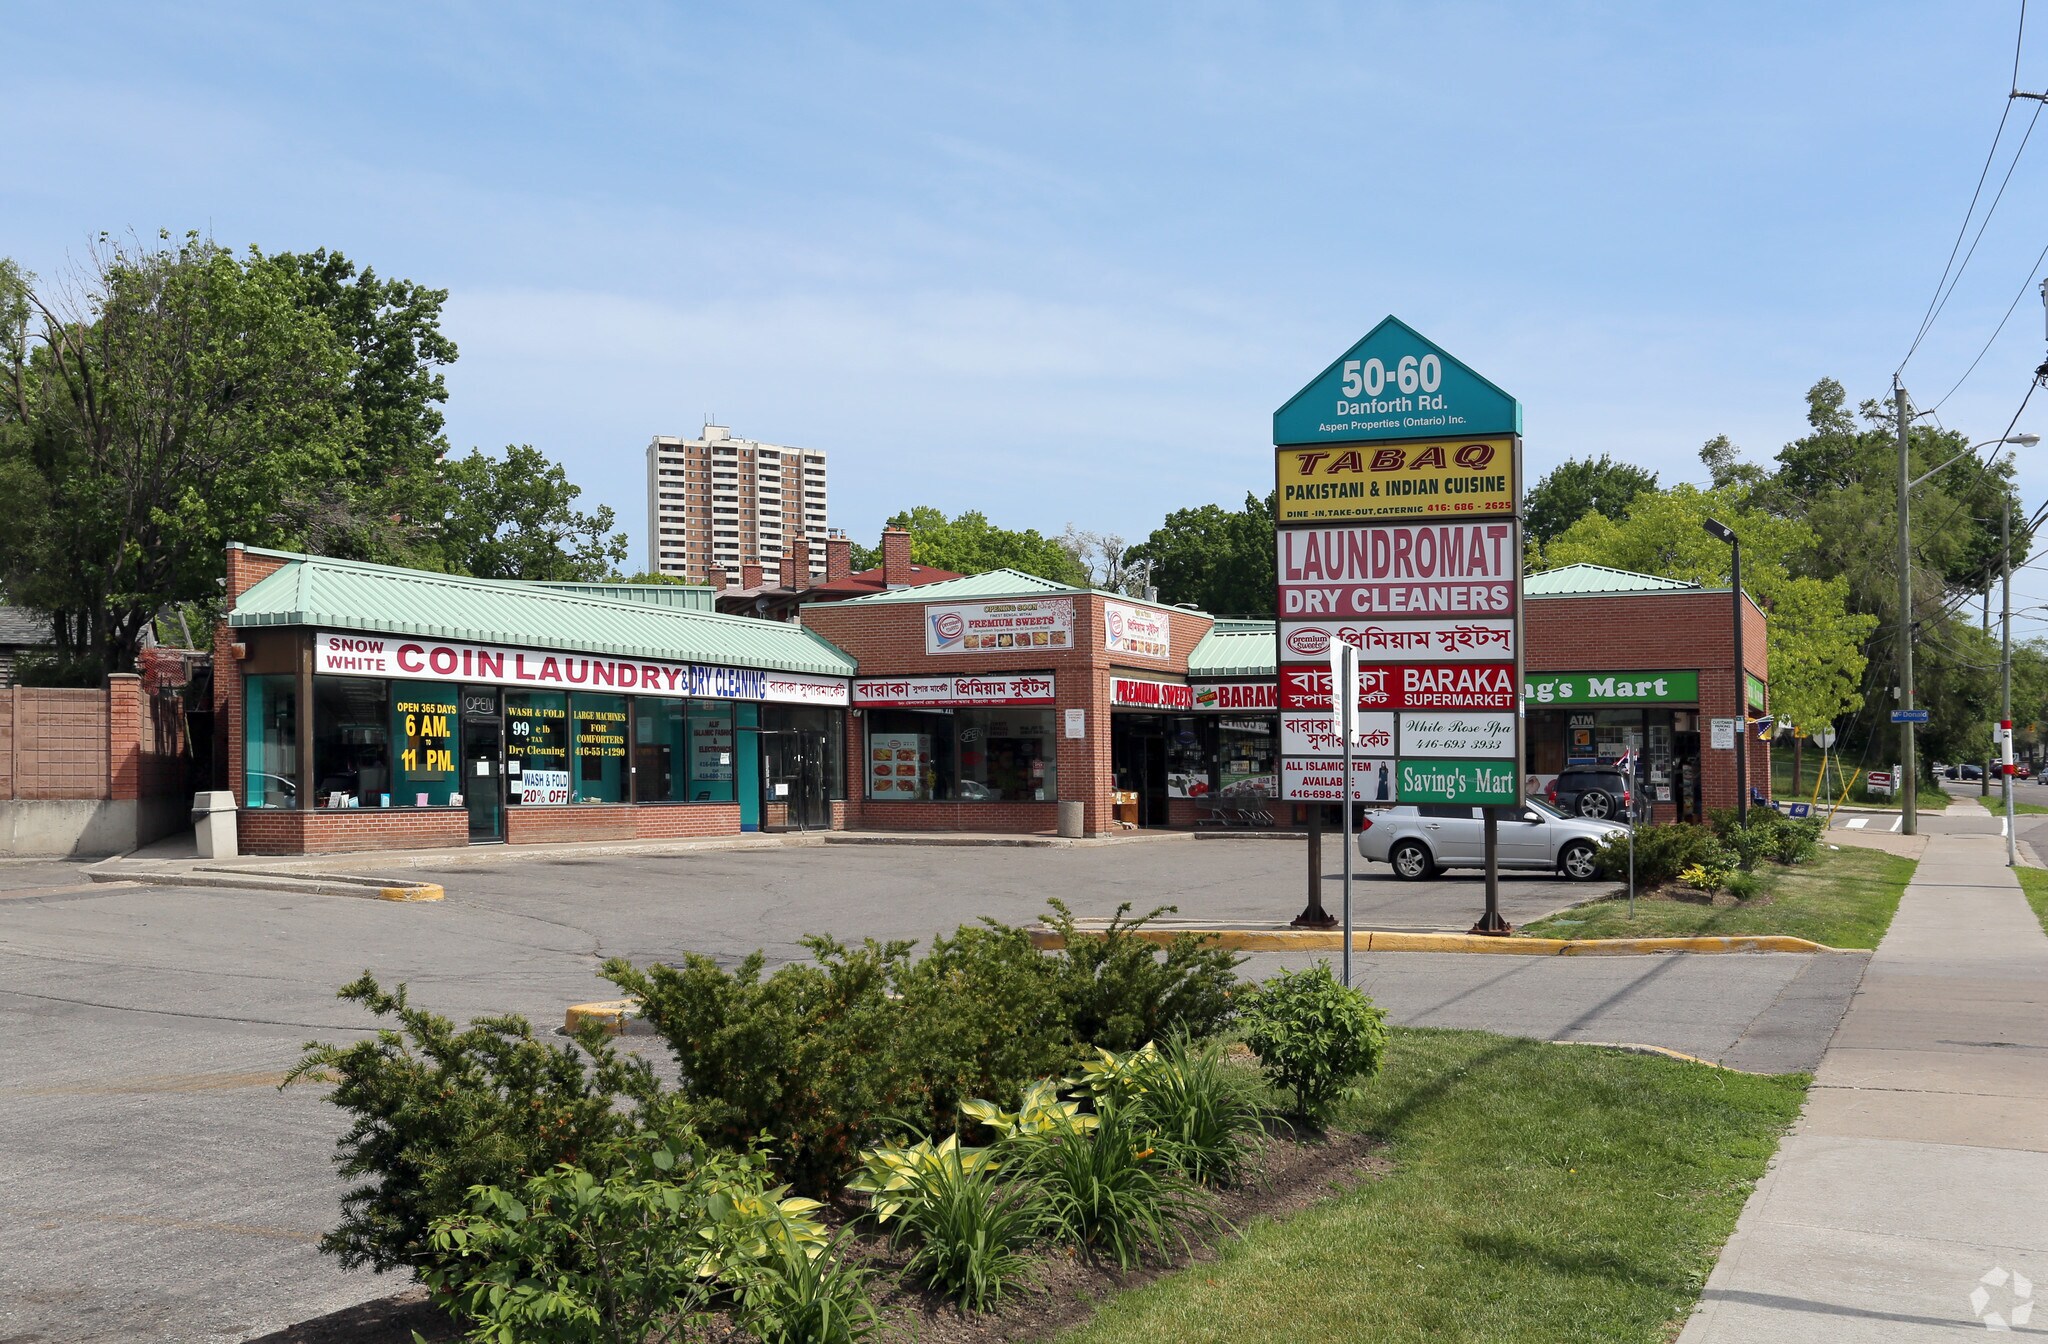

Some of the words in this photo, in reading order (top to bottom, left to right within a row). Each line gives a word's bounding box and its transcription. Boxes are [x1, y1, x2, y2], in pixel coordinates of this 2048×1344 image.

[1342, 354, 1441, 398] 50-60
[1336, 397, 1412, 416] Danforth
[1418, 395, 1448, 411] Rd.
[1318, 423, 1348, 433] Aspen
[1351, 419, 1400, 431] Properties
[1403, 415, 1445, 427] (Ontario)
[1449, 415, 1466, 425] Inc.
[1297, 444, 1495, 475] TABAQ
[1285, 481, 1364, 500] PAKISTANI
[1370, 480, 1380, 497] &
[1386, 479, 1439, 496] INDIAN
[1444, 475, 1505, 494] CUISINE
[1454, 502, 1474, 511] 686
[1485, 501, 1512, 510] 2625
[1285, 525, 1508, 581] LAUNDROMAT
[1285, 588, 1342, 613] DRY
[1351, 585, 1509, 612] CLEANERS
[984, 604, 1016, 613] OPENING
[969, 618, 1013, 628] PREMIUM
[1016, 616, 1055, 626] SWEETS
[329, 638, 384, 653] SNOW
[327, 655, 386, 671] WHITE
[397, 644, 504, 678] COIN
[515, 654, 682, 690] LAUNDRY
[681, 670, 688, 690] &
[691, 664, 712, 695] DRY
[716, 667, 766, 699] CLEANING
[1404, 669, 1513, 692] BARAKA
[1588, 677, 1668, 698] Mart
[1116, 680, 1160, 704] PREMIUM
[1162, 684, 1194, 708] SWEETS
[1218, 686, 1278, 708] BARAK
[1404, 694, 1513, 706] SUPERMARKET
[397, 702, 419, 713] OPEN
[421, 703, 435, 713] 365
[437, 704, 457, 714] DAYS
[466, 697, 493, 710] OPEN
[508, 707, 532, 717] WASH
[535, 708, 541, 717] &
[543, 709, 565, 718] FOLD
[574, 711, 594, 720] LARGE
[596, 712, 625, 721] MACHINES
[405, 714, 416, 737] 6
[421, 715, 450, 737] AM.
[1570, 715, 1594, 725] ATM
[513, 721, 530, 735] 99
[542, 725, 550, 733] lb
[590, 724, 606, 732] FOR
[1448, 720, 1480, 733] Rose
[1484, 720, 1512, 737] Spa
[576, 734, 624, 744] COMFORTERS
[1471, 739, 1501, 749] 3933
[508, 745, 524, 757] Dry
[527, 745, 565, 757] Cleaning
[575, 747, 625, 756] 416-551-1290
[402, 748, 416, 771] 11
[427, 749, 455, 772] PM.
[1285, 762, 1303, 771] ALL
[1306, 762, 1344, 771] ISLAMIC
[1351, 762, 1371, 771] TEM
[524, 773, 543, 787] WASH
[546, 773, 550, 787] &
[552, 774, 567, 787] FOLD
[1404, 767, 1466, 799] Saving's
[1475, 768, 1513, 794] Mart
[523, 789, 546, 803] 20%
[549, 790, 567, 803] OFF
